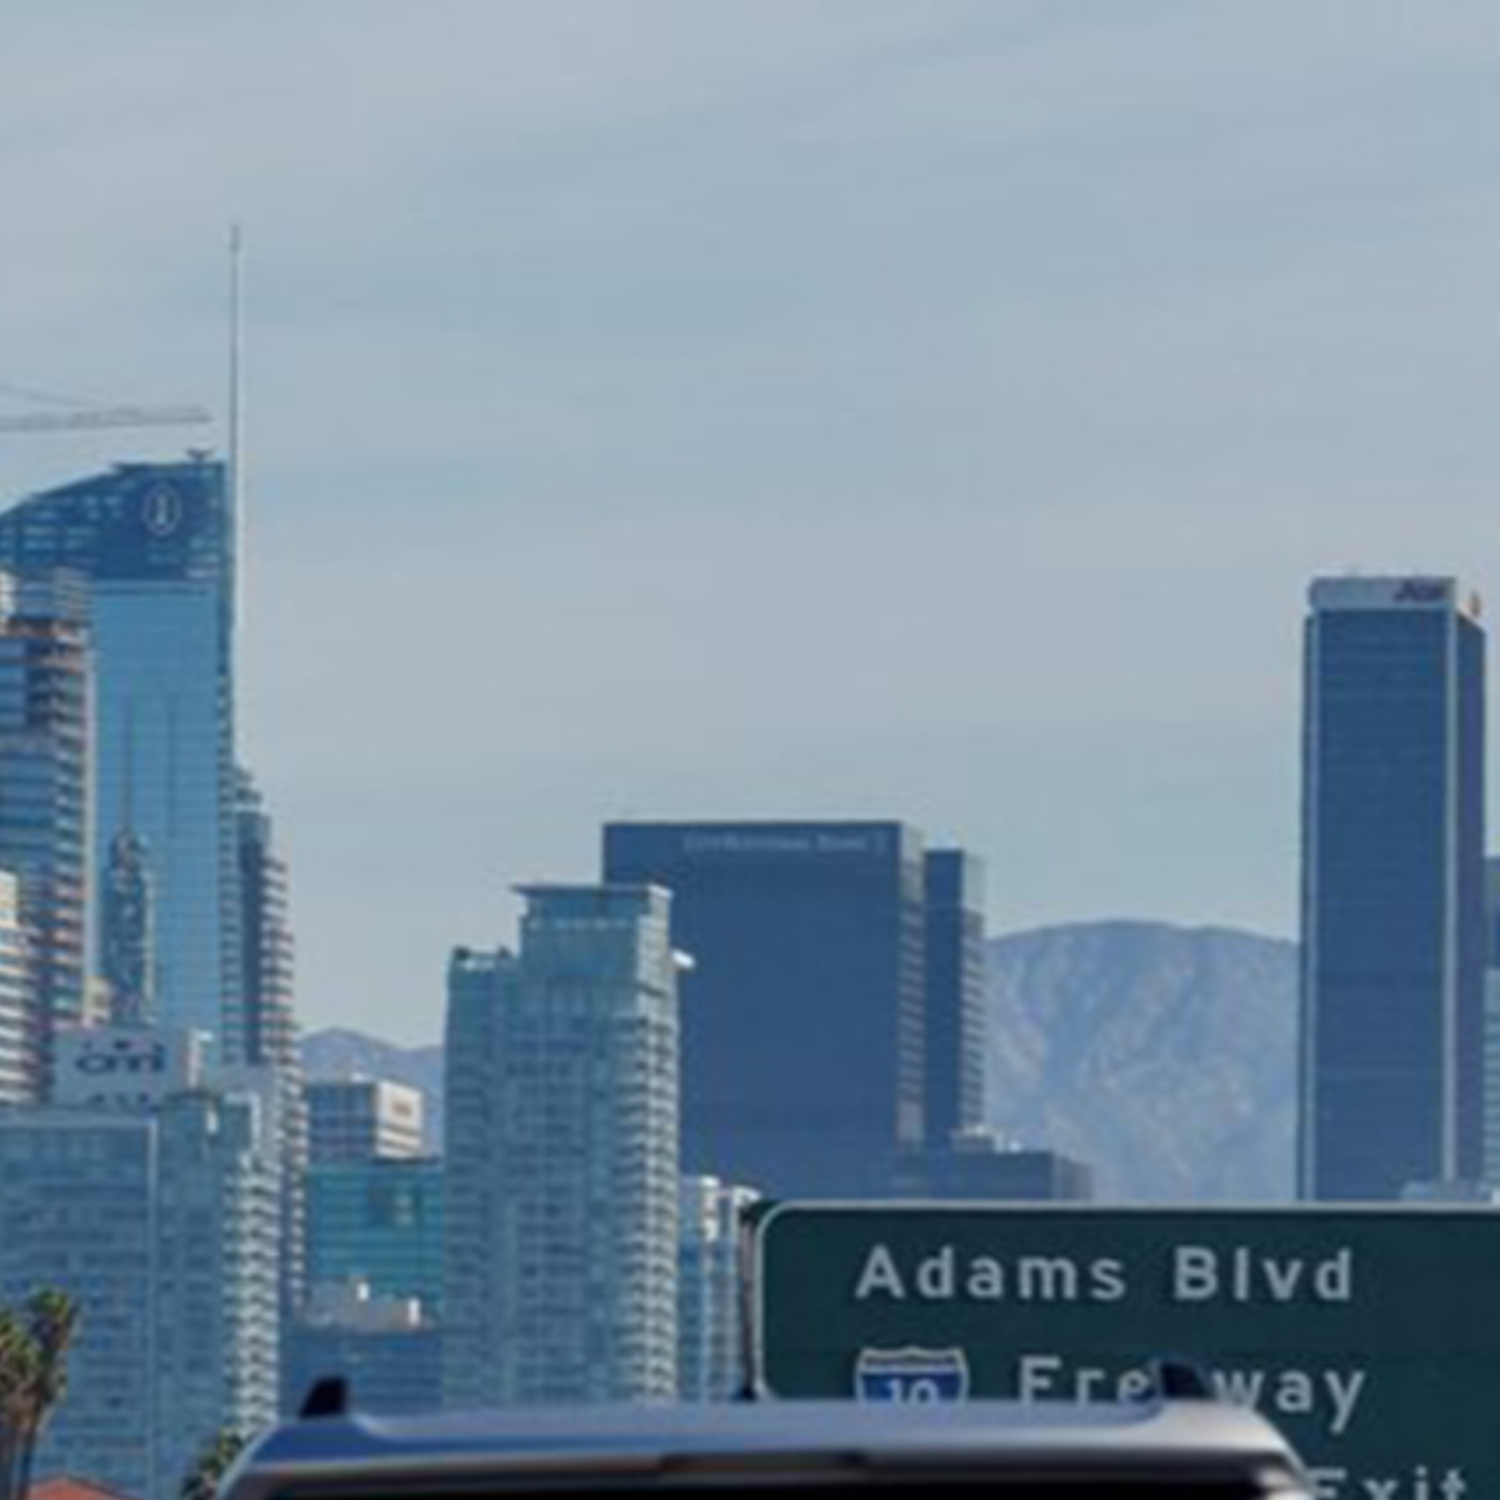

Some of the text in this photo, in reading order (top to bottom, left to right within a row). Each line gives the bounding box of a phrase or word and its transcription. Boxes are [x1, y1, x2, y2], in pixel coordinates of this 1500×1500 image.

[855, 1245, 1353, 1301] Adams Blvd
[1018, 1355, 1367, 1434] Freway
